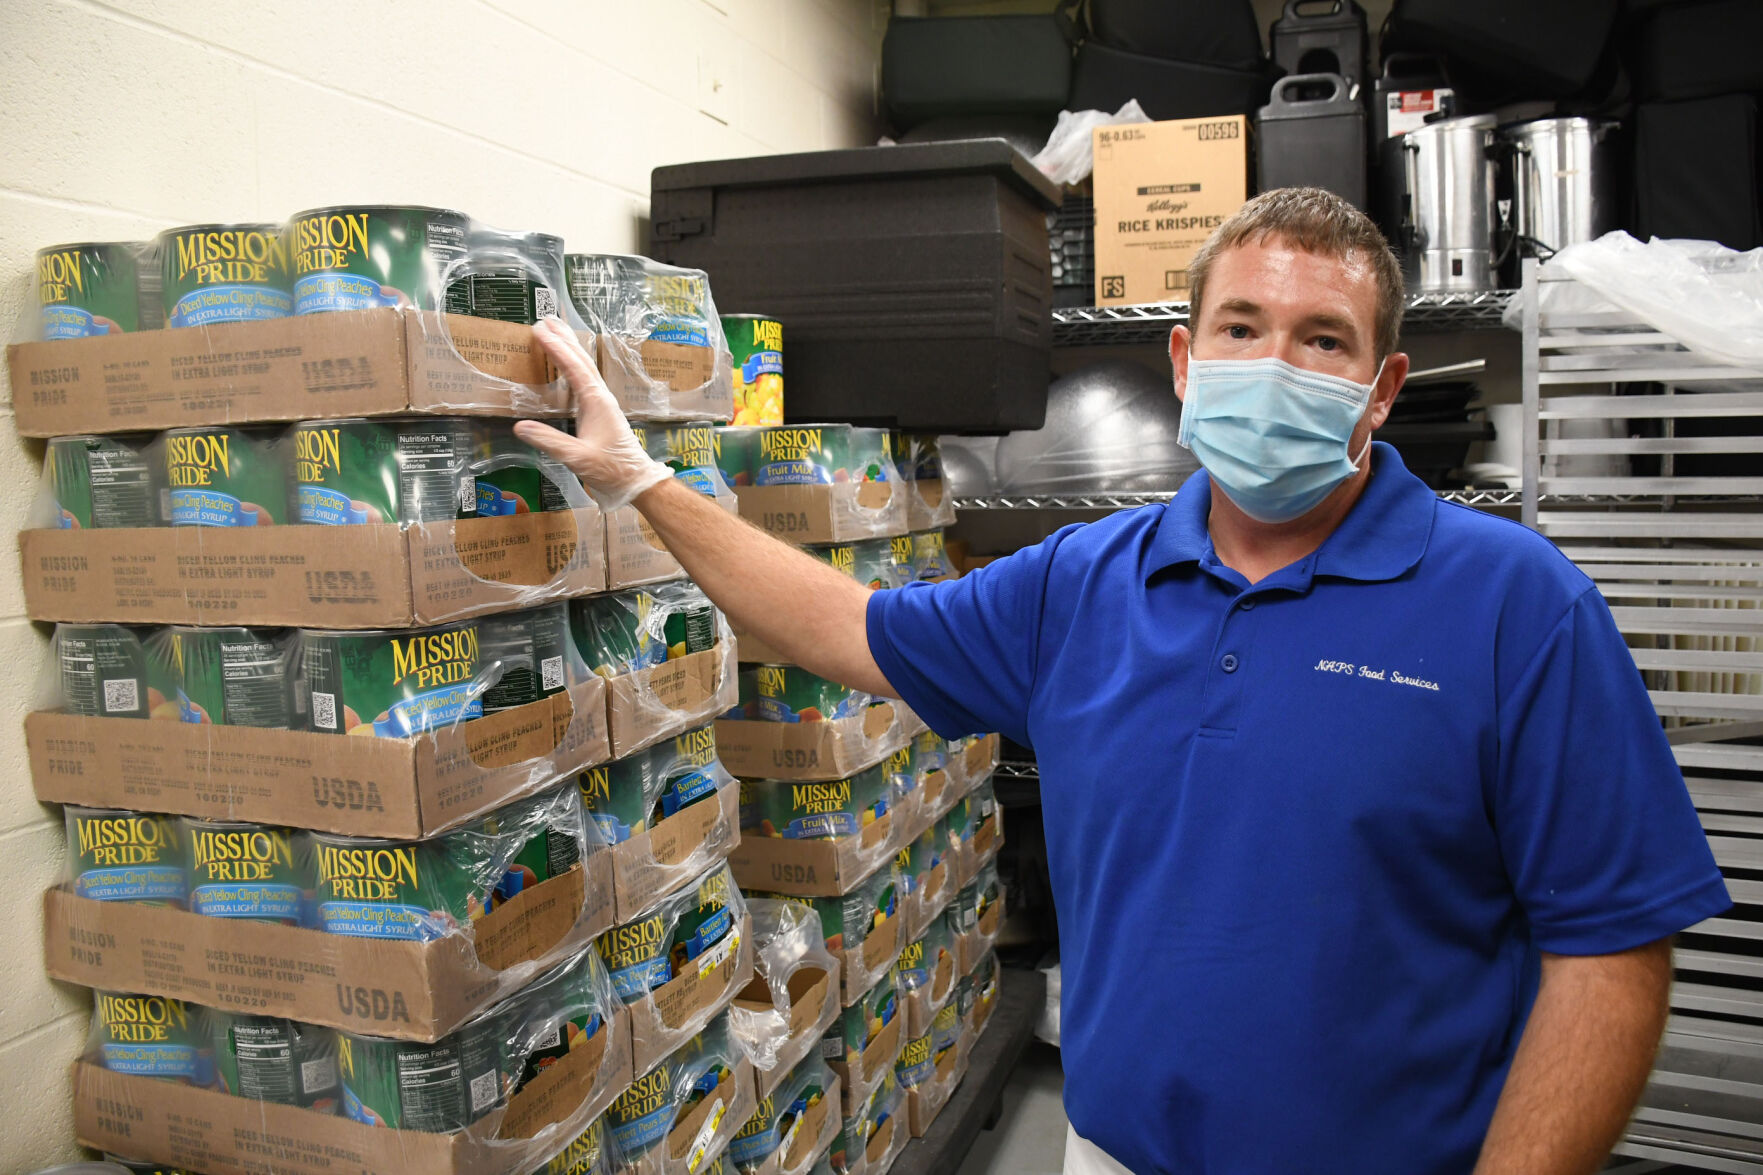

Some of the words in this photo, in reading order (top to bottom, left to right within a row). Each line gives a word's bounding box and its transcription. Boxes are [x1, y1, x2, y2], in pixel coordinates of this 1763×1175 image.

[1199, 122, 1238, 140] 00596
[1146, 200, 1188, 213] Kellogg's
[1118, 220, 1150, 233] RICE
[1156, 216, 1222, 231] KRISPIES
[176, 231, 288, 280] MISSION
[297, 248, 349, 274] PRIDE
[196, 262, 269, 285] PRIDE
[1104, 278, 1123, 297] FS
[201, 292, 231, 306] Yellow
[230, 290, 255, 307] Cling
[30, 367, 80, 385] MISSION
[183, 367, 210, 380] EXTRA
[213, 365, 239, 377] LIGHT
[399, 435, 429, 443] Nutrition
[430, 434, 447, 442] Facts
[760, 429, 822, 458] MISSION
[447, 460, 455, 468] 60
[770, 448, 810, 461] PRIDE
[768, 465, 789, 475] Fruit
[792, 464, 813, 475] Mix
[201, 495, 234, 512] Peaches
[201, 511, 227, 522] SYRUP
[764, 512, 810, 531] USDA
[40, 556, 89, 571] MISSION
[463, 554, 483, 566] LIGHT
[485, 550, 506, 562] SYRUP
[546, 540, 592, 575] USDA
[178, 567, 187, 579] IN
[189, 567, 216, 578] EXTRA
[218, 567, 244, 579] LIGHT
[246, 568, 276, 579] SYRUP
[427, 588, 473, 602] 100220
[187, 600, 238, 610] 100220
[390, 626, 479, 686] MISSION
[416, 661, 473, 688] PRIDE
[1314, 659, 1354, 675] NAPS
[1358, 666, 1385, 681] Food
[1390, 671, 1440, 691] Services
[49, 759, 83, 776] PRIDE
[772, 749, 819, 768] USDA
[312, 776, 384, 812] USDA
[792, 780, 851, 811] MISSION
[806, 799, 843, 814] PRIDE
[802, 819, 825, 829] Fruit
[77, 815, 179, 857] MISSION
[93, 845, 160, 865] PRIDE
[191, 829, 293, 871] MISSION
[207, 861, 274, 881] PRIDE
[316, 843, 418, 891] MISSION
[772, 863, 817, 884] USDA
[124, 871, 147, 887] Cling
[332, 878, 398, 899] PRIDE
[211, 889, 237, 902] Yellow
[237, 888, 260, 905] Cling
[233, 904, 258, 913] LIGHT
[261, 904, 291, 913] SYRUP
[69, 927, 116, 948] MISSION
[357, 923, 383, 932] LIGHT
[385, 925, 416, 935] SYRUP
[593, 911, 665, 959] MISSION
[71, 947, 103, 967] PRIDE
[205, 949, 230, 962] DICED
[232, 952, 266, 966] YELLOW
[269, 956, 296, 970] CLING
[611, 942, 659, 969] PRIDE
[207, 962, 217, 973] IN
[218, 963, 246, 976] EXTRA
[249, 966, 273, 979] LIGHT
[276, 970, 305, 984] SYRUP
[217, 993, 268, 1008] 100220
[336, 983, 410, 1023] USDA
[110, 1023, 168, 1042] PRIDE
[234, 1026, 259, 1035] Nutrition
[260, 1027, 279, 1035] Facts
[398, 1052, 429, 1062] Nutrition
[430, 1048, 450, 1059] Facts
[401, 1077, 426, 1085] Calories
[450, 1069, 461, 1077] 60
[621, 1092, 665, 1122] PRIDE
[97, 1116, 131, 1138] PRIDE
[234, 1141, 243, 1151] IN
[302, 1150, 331, 1168] SYRUP
